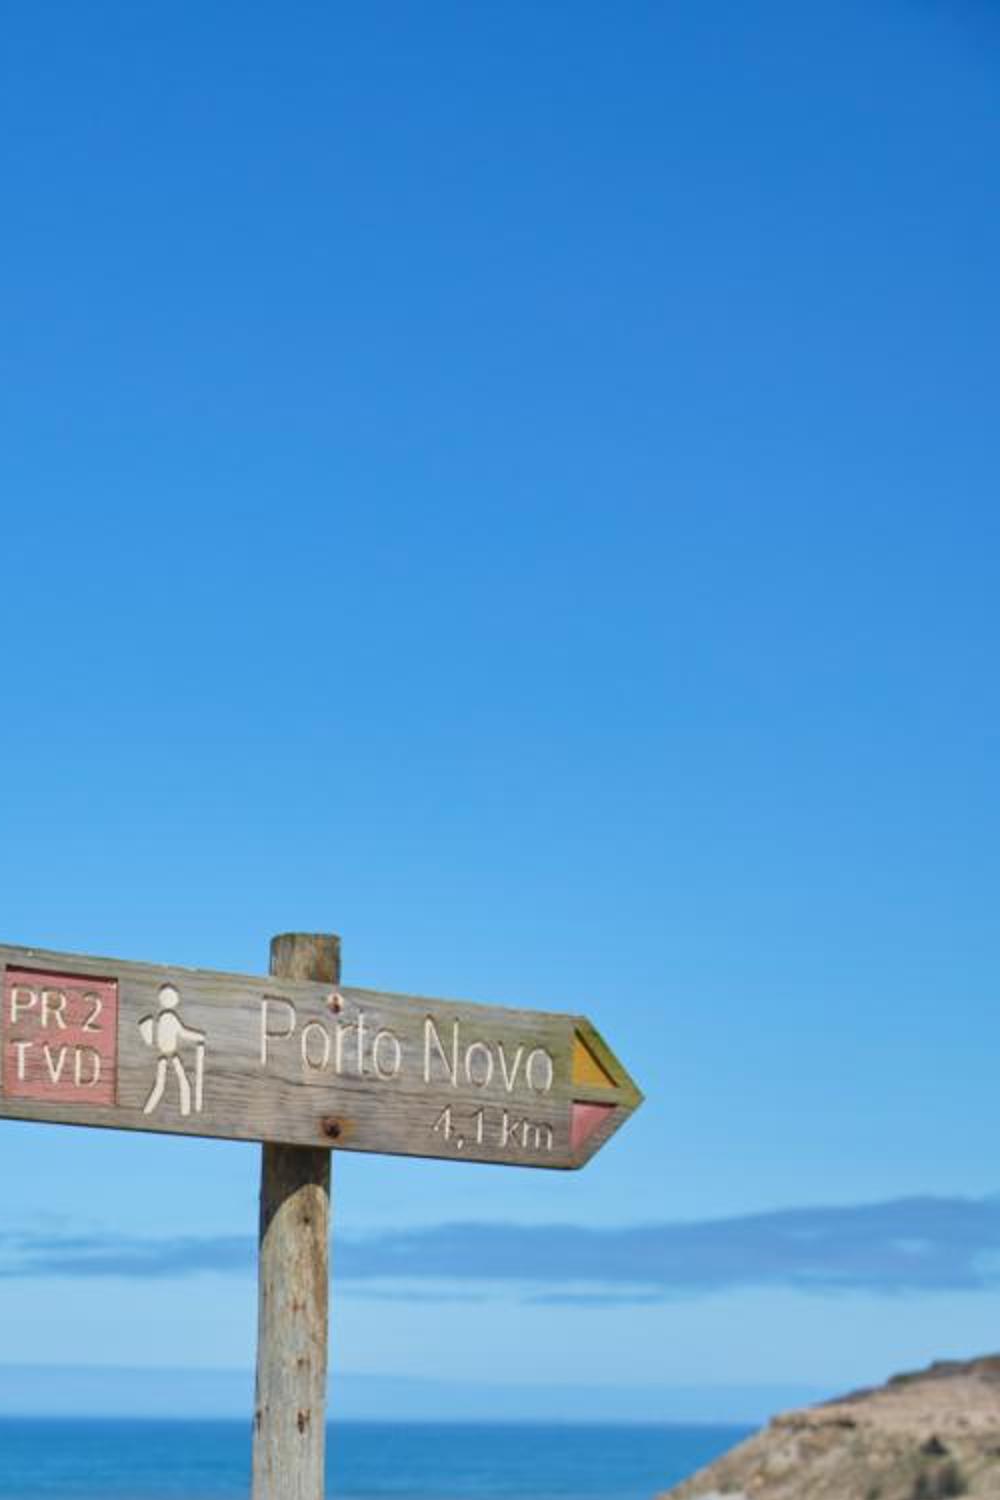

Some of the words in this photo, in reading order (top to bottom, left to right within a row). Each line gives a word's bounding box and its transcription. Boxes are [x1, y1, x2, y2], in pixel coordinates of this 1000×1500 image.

[10, 983, 68, 1030] PR
[82, 991, 104, 1033] 2
[9, 1038, 101, 1088] TVD
[259, 993, 402, 1081] Porto
[422, 1014, 555, 1095] Novo
[432, 1103, 486, 1150] 4,1
[501, 1108, 554, 1152] km
